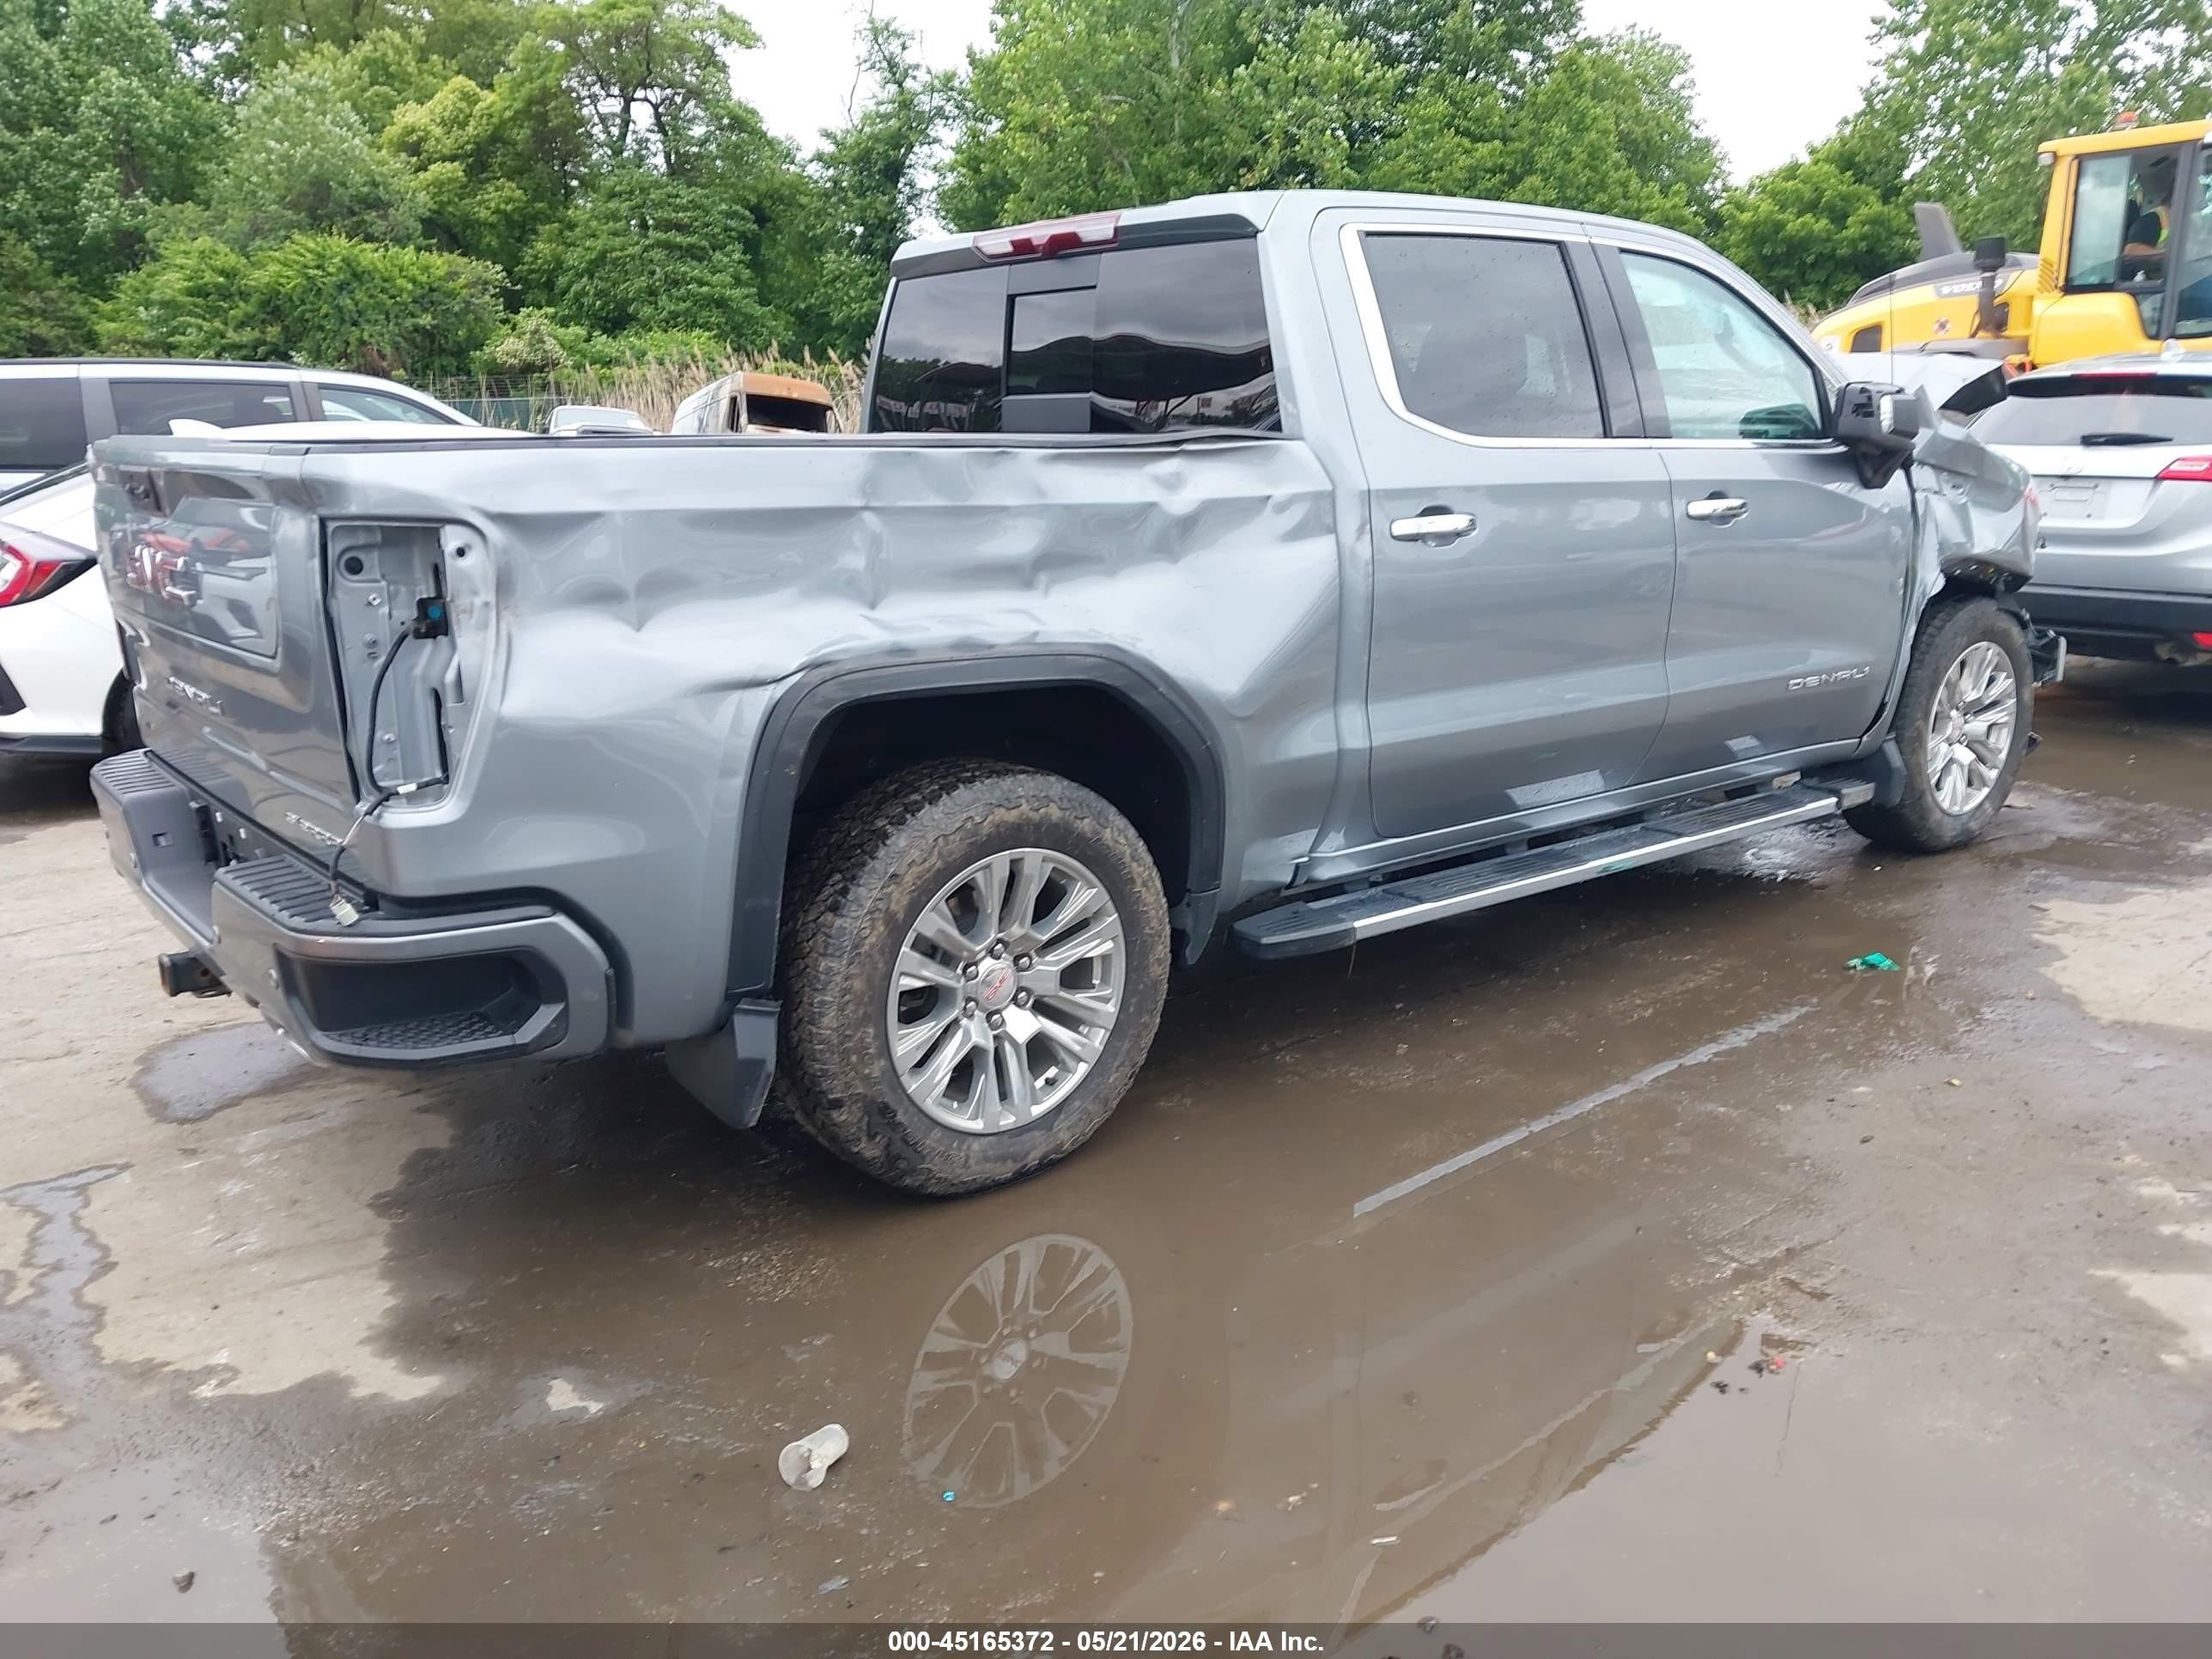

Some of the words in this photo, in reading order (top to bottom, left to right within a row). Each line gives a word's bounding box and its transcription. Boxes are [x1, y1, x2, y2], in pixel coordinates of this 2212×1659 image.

[125, 542, 198, 606] GMC
[1787, 665, 1871, 690] DENALI
[984, 968, 1012, 1004] GMC
